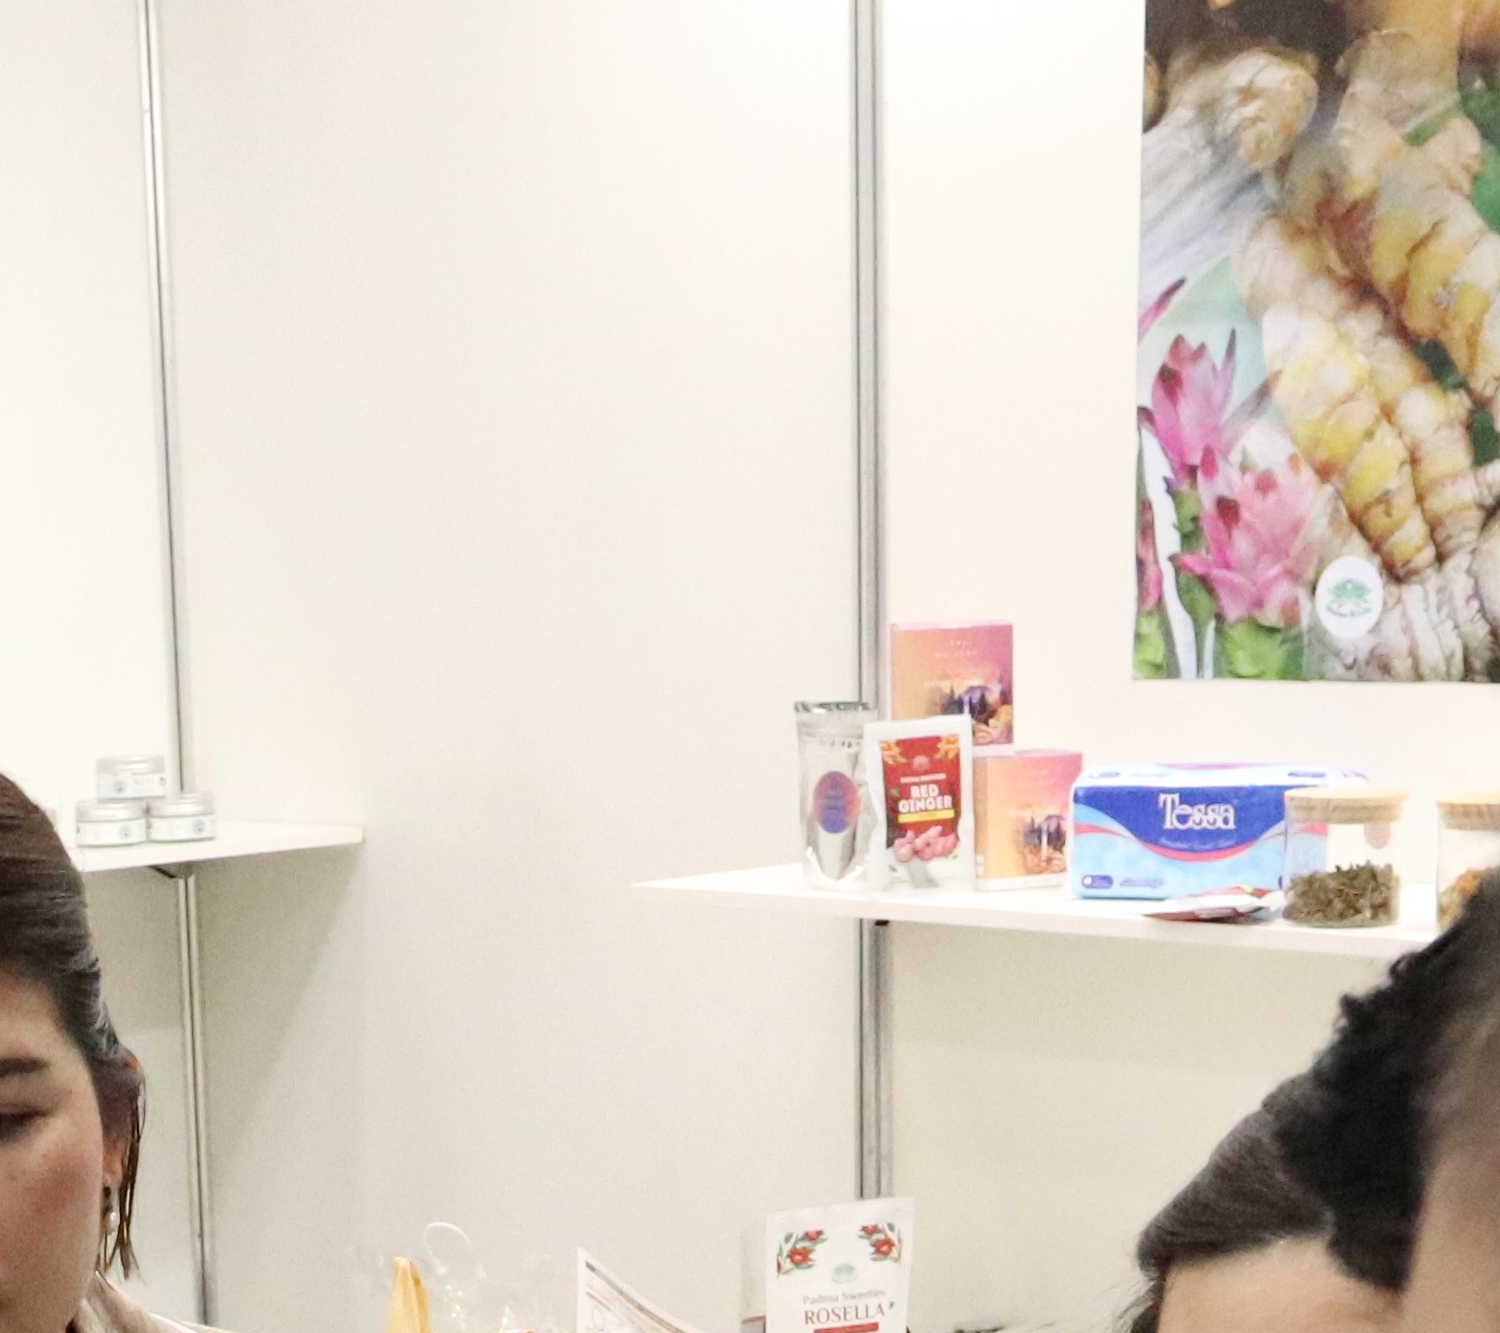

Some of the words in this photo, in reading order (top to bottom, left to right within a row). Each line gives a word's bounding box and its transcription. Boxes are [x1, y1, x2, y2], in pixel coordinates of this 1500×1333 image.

[911, 784, 939, 798] RED
[898, 795, 953, 813] GINGER
[1159, 793, 1236, 830] Tessa
[804, 1302, 885, 1325] ROSELLA
